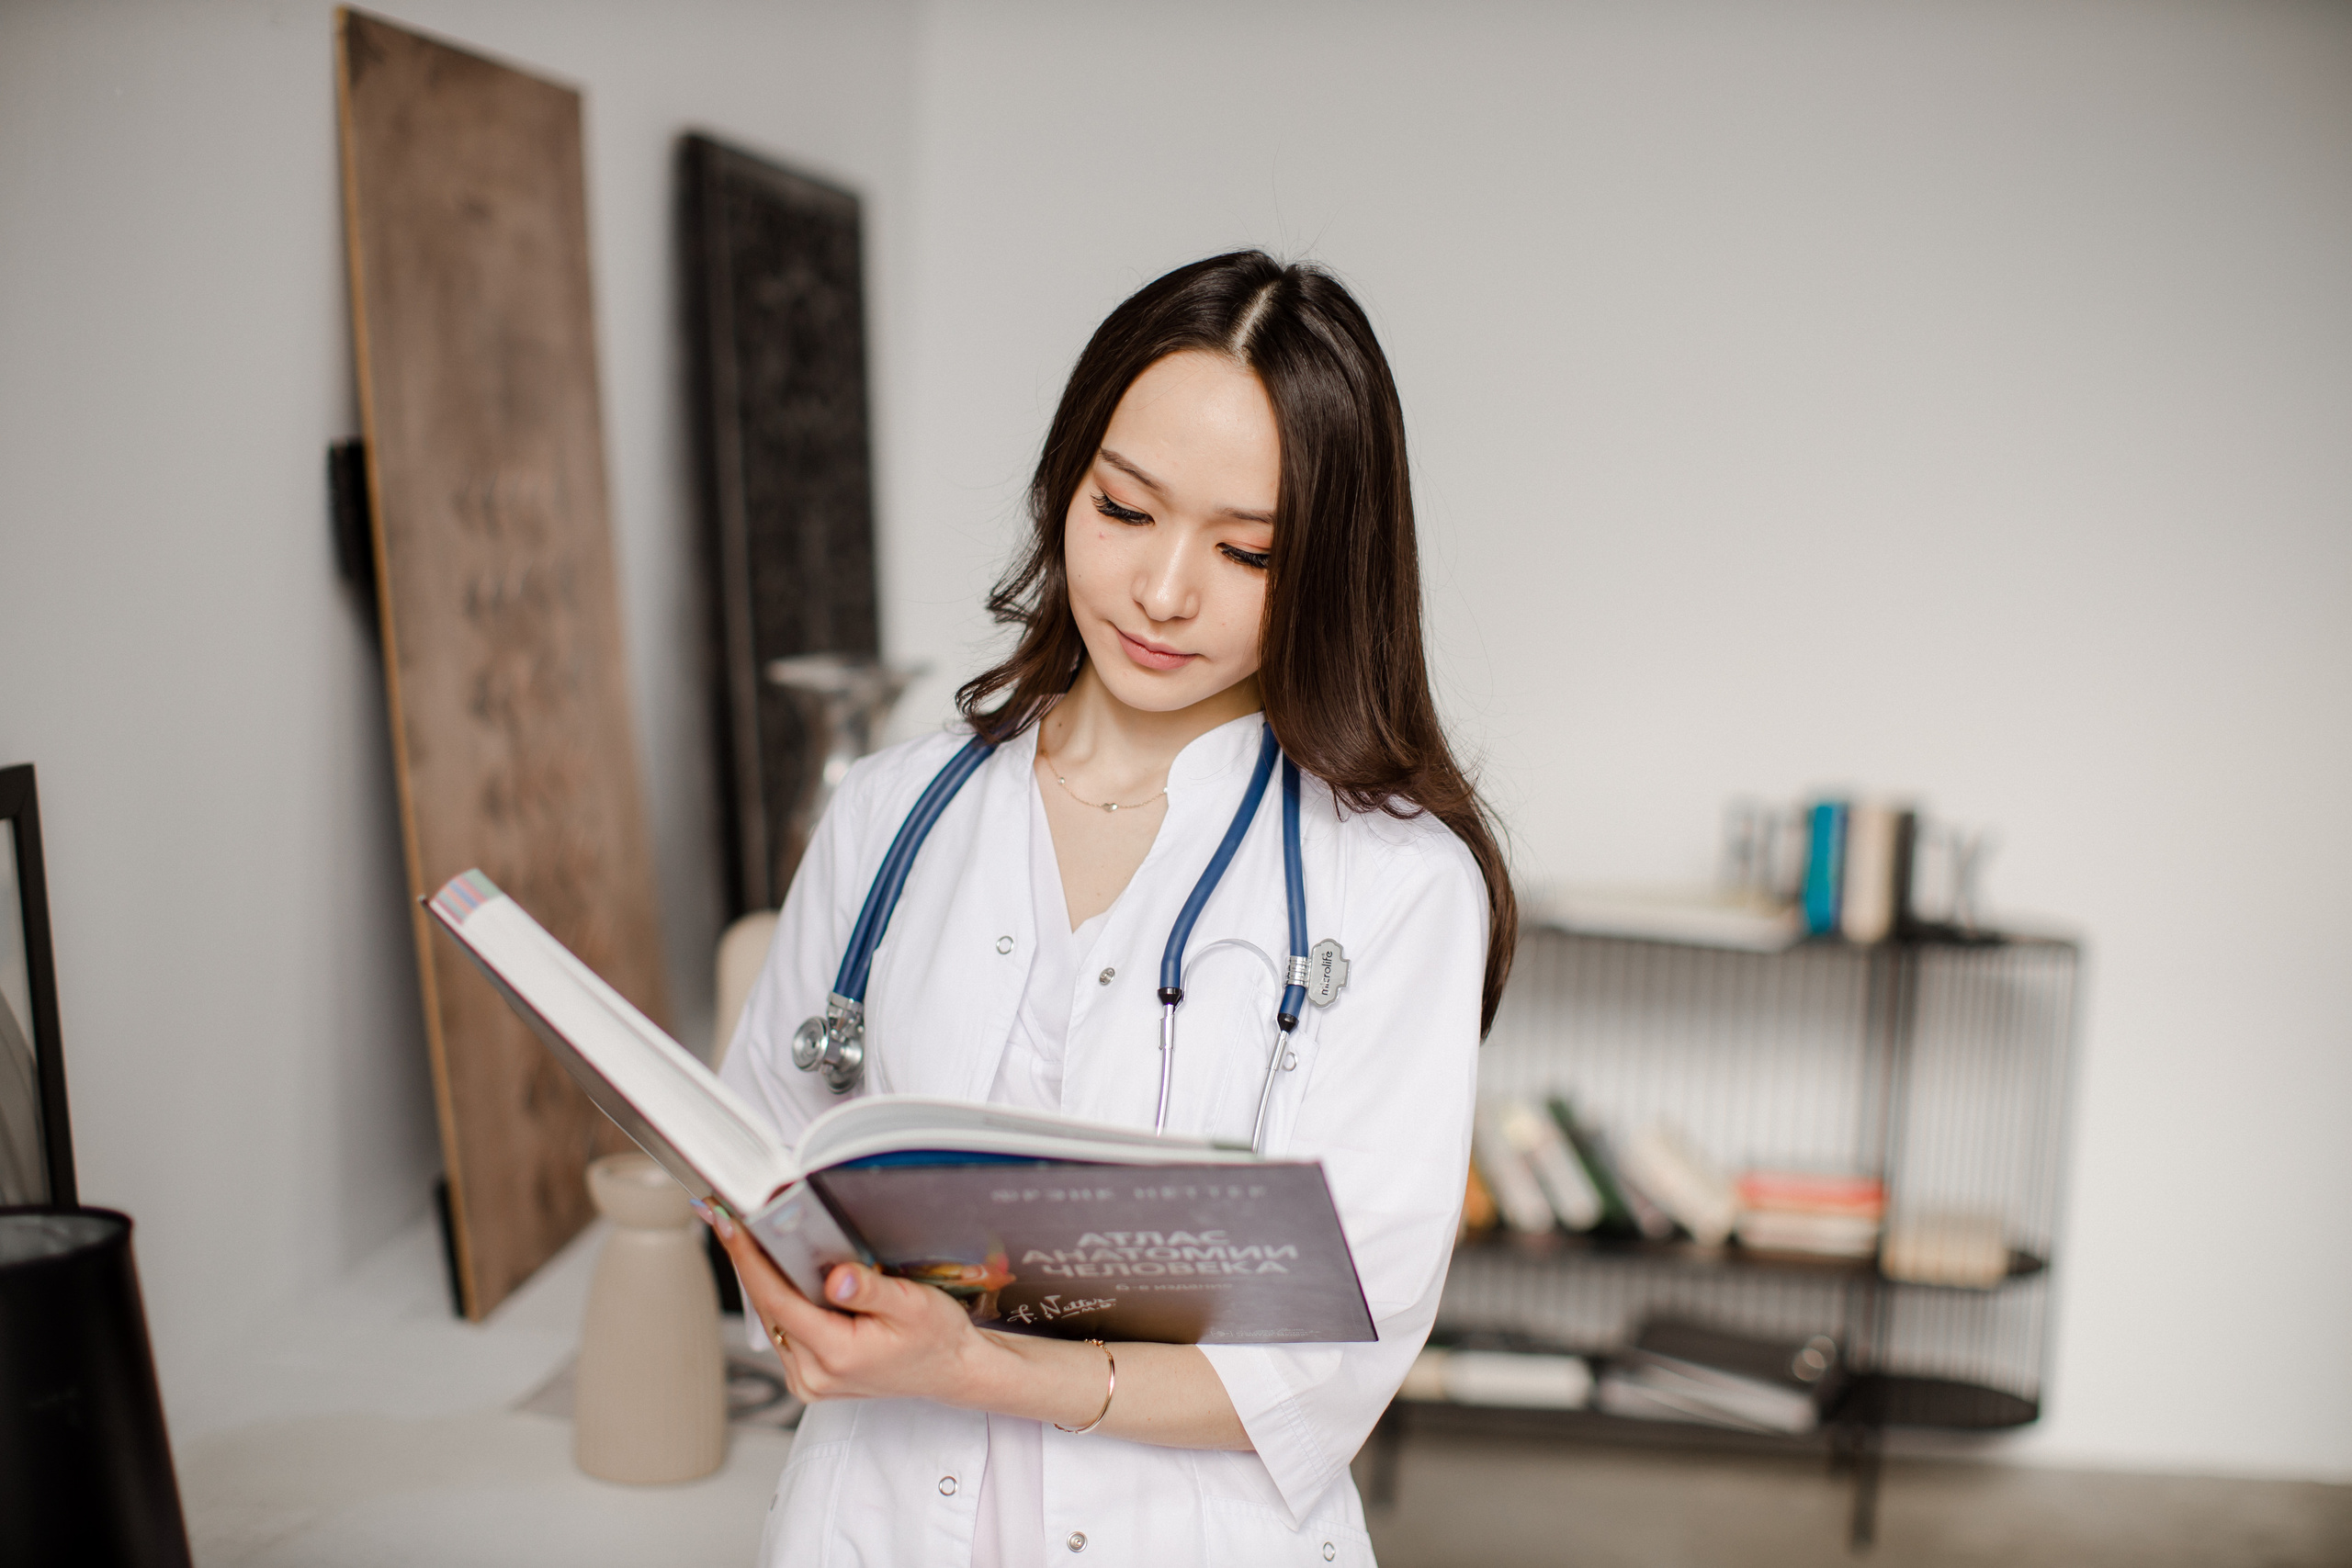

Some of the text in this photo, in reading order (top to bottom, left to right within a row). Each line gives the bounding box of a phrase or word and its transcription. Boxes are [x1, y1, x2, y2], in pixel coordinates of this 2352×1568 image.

[1077, 1230, 1230, 1248] АТЛАС
[1022, 1245, 1299, 1265] АНАТОМИИ
[1042, 1260, 1289, 1279] ЧЕЛОВЕКА
